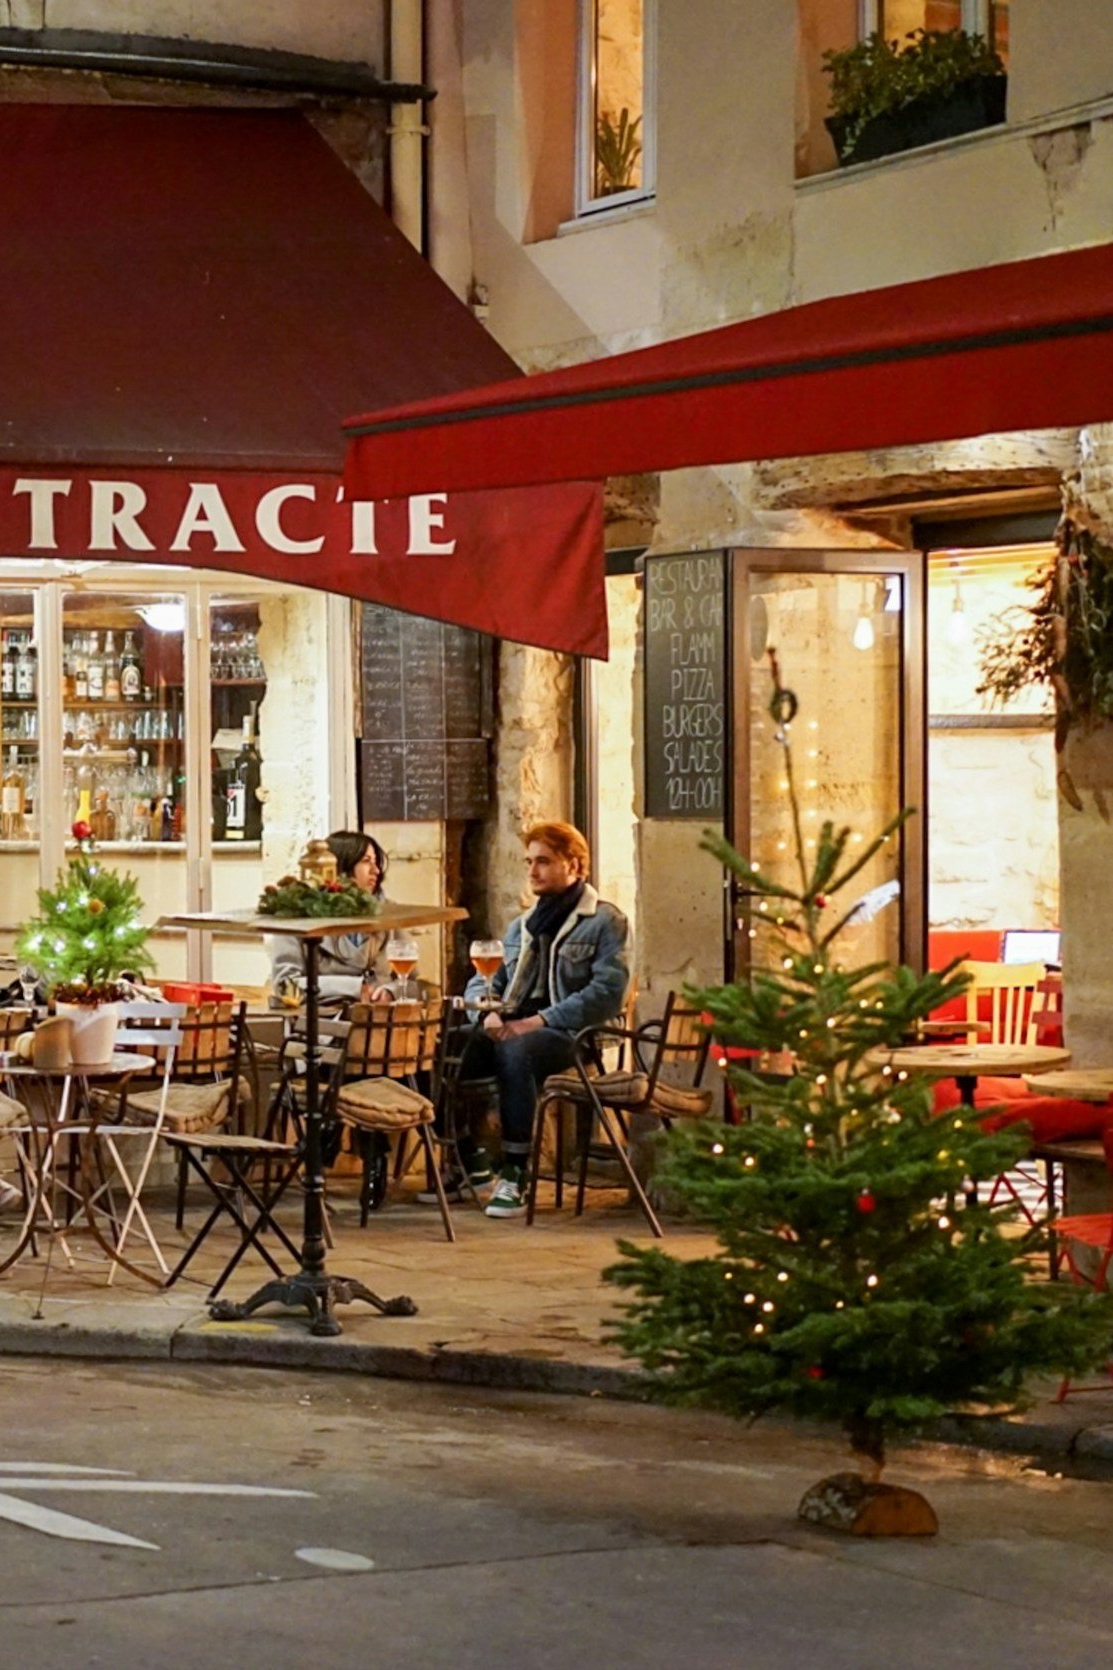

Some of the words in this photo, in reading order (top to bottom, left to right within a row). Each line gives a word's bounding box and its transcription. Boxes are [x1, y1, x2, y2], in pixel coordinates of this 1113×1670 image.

[650, 597, 677, 633] BAR
[683, 596, 694, 629] &
[670, 632, 715, 665] FLAMM
[671, 668, 716, 700] PIZZA
[662, 703, 724, 739] BURGERS
[663, 740, 723, 775] SALADES
